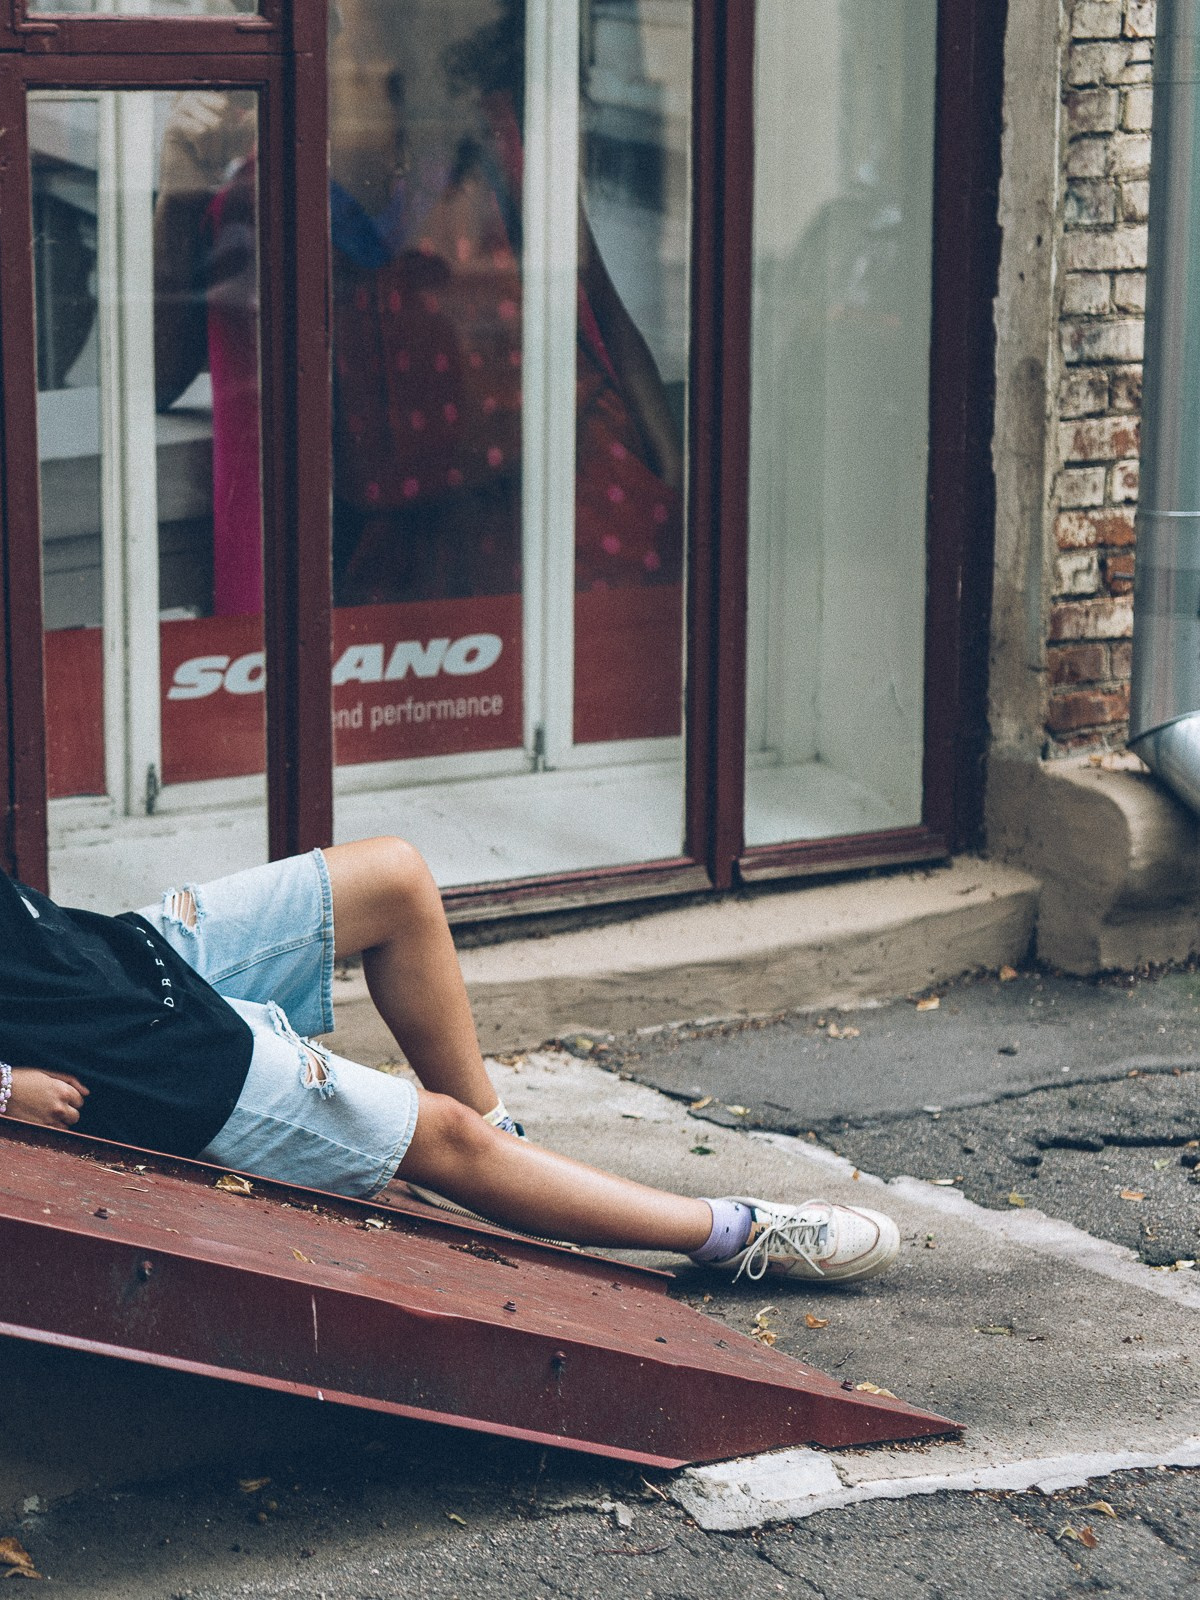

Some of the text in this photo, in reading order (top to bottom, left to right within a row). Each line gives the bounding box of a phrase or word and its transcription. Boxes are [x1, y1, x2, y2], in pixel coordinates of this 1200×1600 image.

[167, 633, 503, 700] SOANO
[330, 694, 503, 732] nd performance
